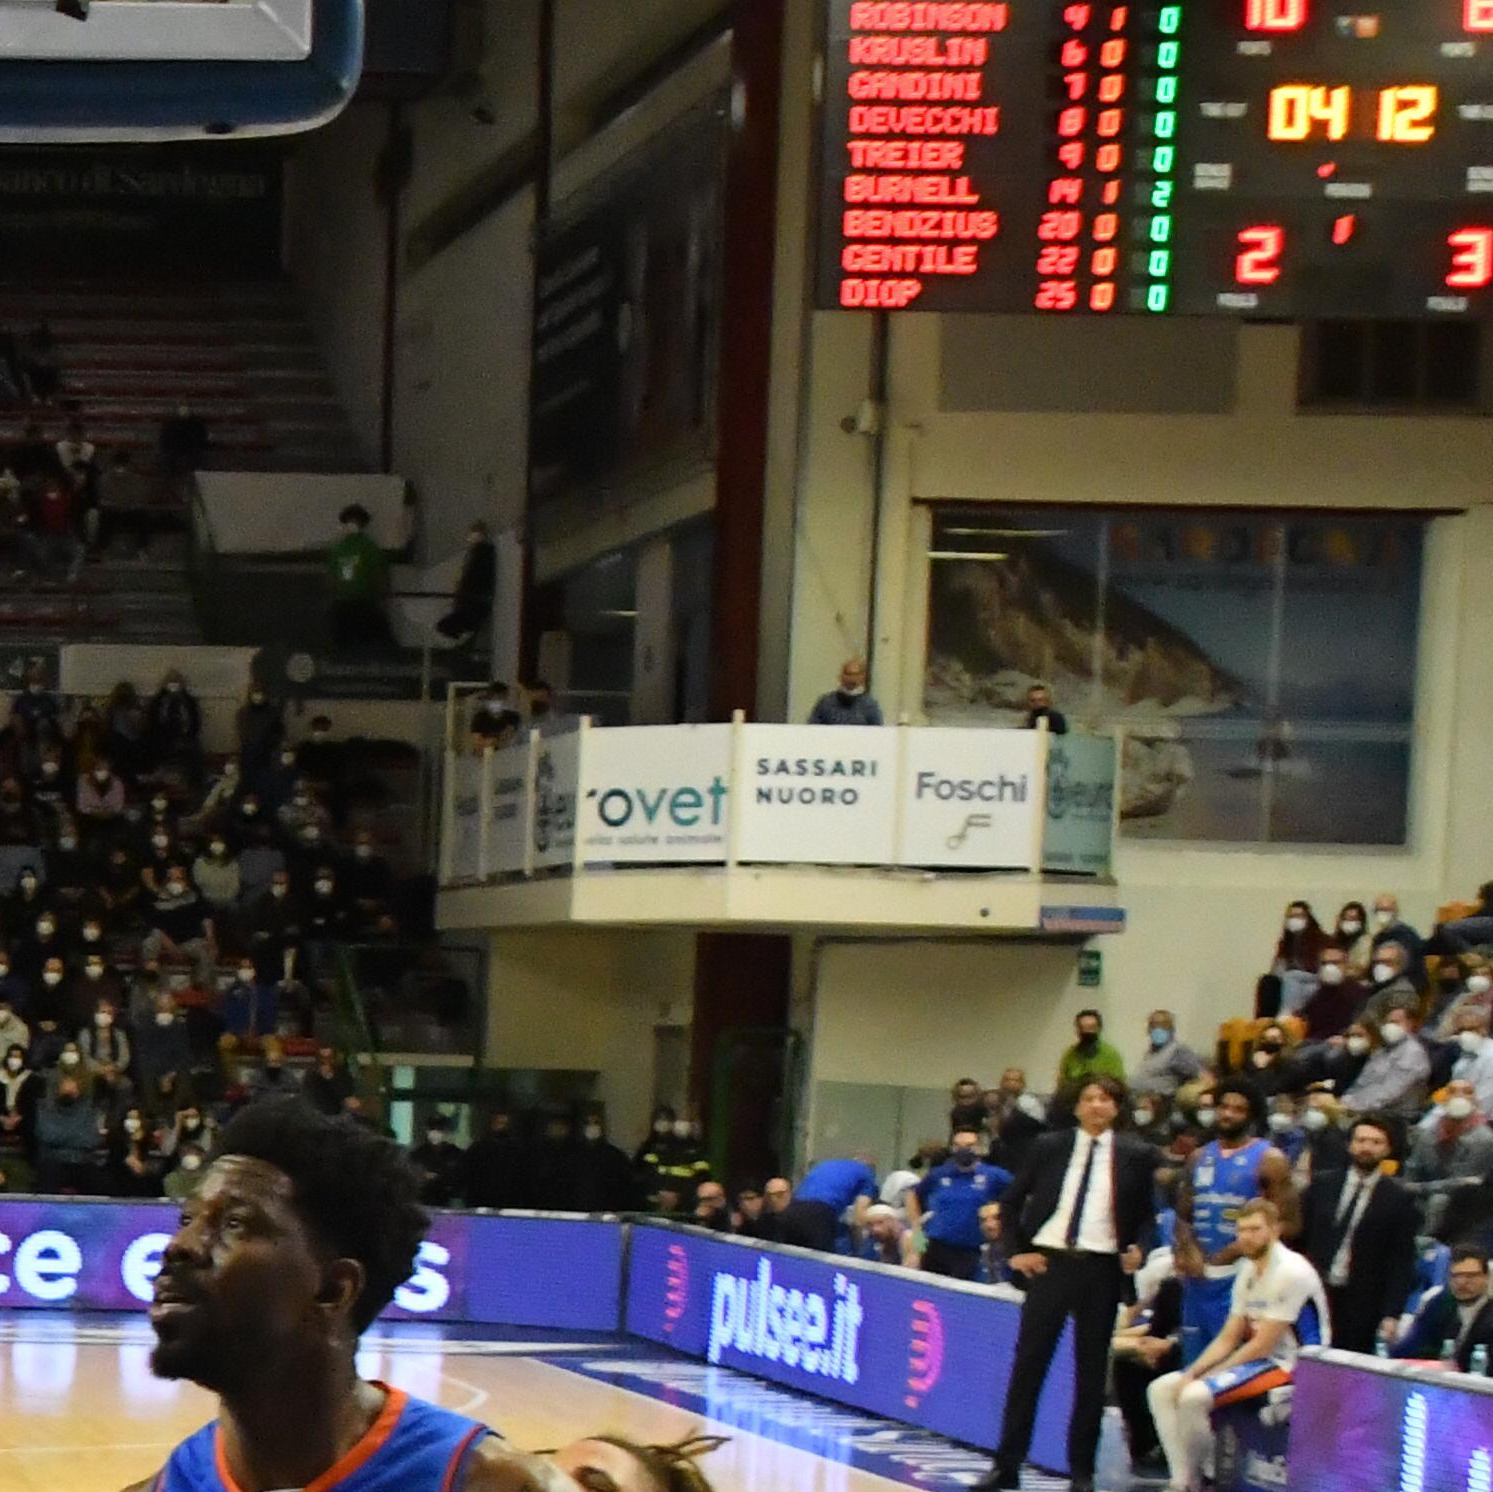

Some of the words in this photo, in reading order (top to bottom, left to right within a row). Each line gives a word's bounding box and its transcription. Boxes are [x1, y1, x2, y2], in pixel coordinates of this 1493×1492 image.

[849, 1, 1007, 31] ROBINSON
[1159, 7, 1181, 33] 0
[1061, 39, 1089, 67] 6
[1100, 39, 1127, 68] 0
[1157, 42, 1179, 68] 0
[1099, 73, 1125, 102] 0
[1156, 76, 1177, 103] 0
[848, 105, 1000, 135] DEVECCHI
[1058, 105, 1086, 137] 8
[1097, 108, 1123, 137] 0
[1154, 111, 1175, 137] 0
[1267, 85, 1351, 141] 04
[1377, 86, 1437, 142] 12
[846, 140, 964, 170] TREIER
[1096, 143, 1122, 172] 0
[1154, 146, 1174, 172] 0
[844, 175, 979, 204] BURNELL
[1152, 181, 1172, 207] 2
[1038, 211, 1082, 240] 20
[1093, 213, 1118, 241] 0
[1151, 215, 1170, 241] 0
[841, 244, 978, 274] GENTILE
[1037, 246, 1080, 275] 22
[1091, 247, 1116, 276] 0
[1149, 250, 1169, 276] 0
[1235, 226, 1284, 284] 2
[1445, 228, 1493, 286] 3
[840, 278, 921, 307] DIOP
[1035, 281, 1077, 310] 25
[1090, 281, 1114, 311] 0
[1148, 284, 1168, 311] 0
[756, 757, 880, 779] SASSARI
[756, 785, 860, 806] NUORO
[915, 771, 1030, 804] Foschi
[708, 1256, 865, 1385] pulsee.it
